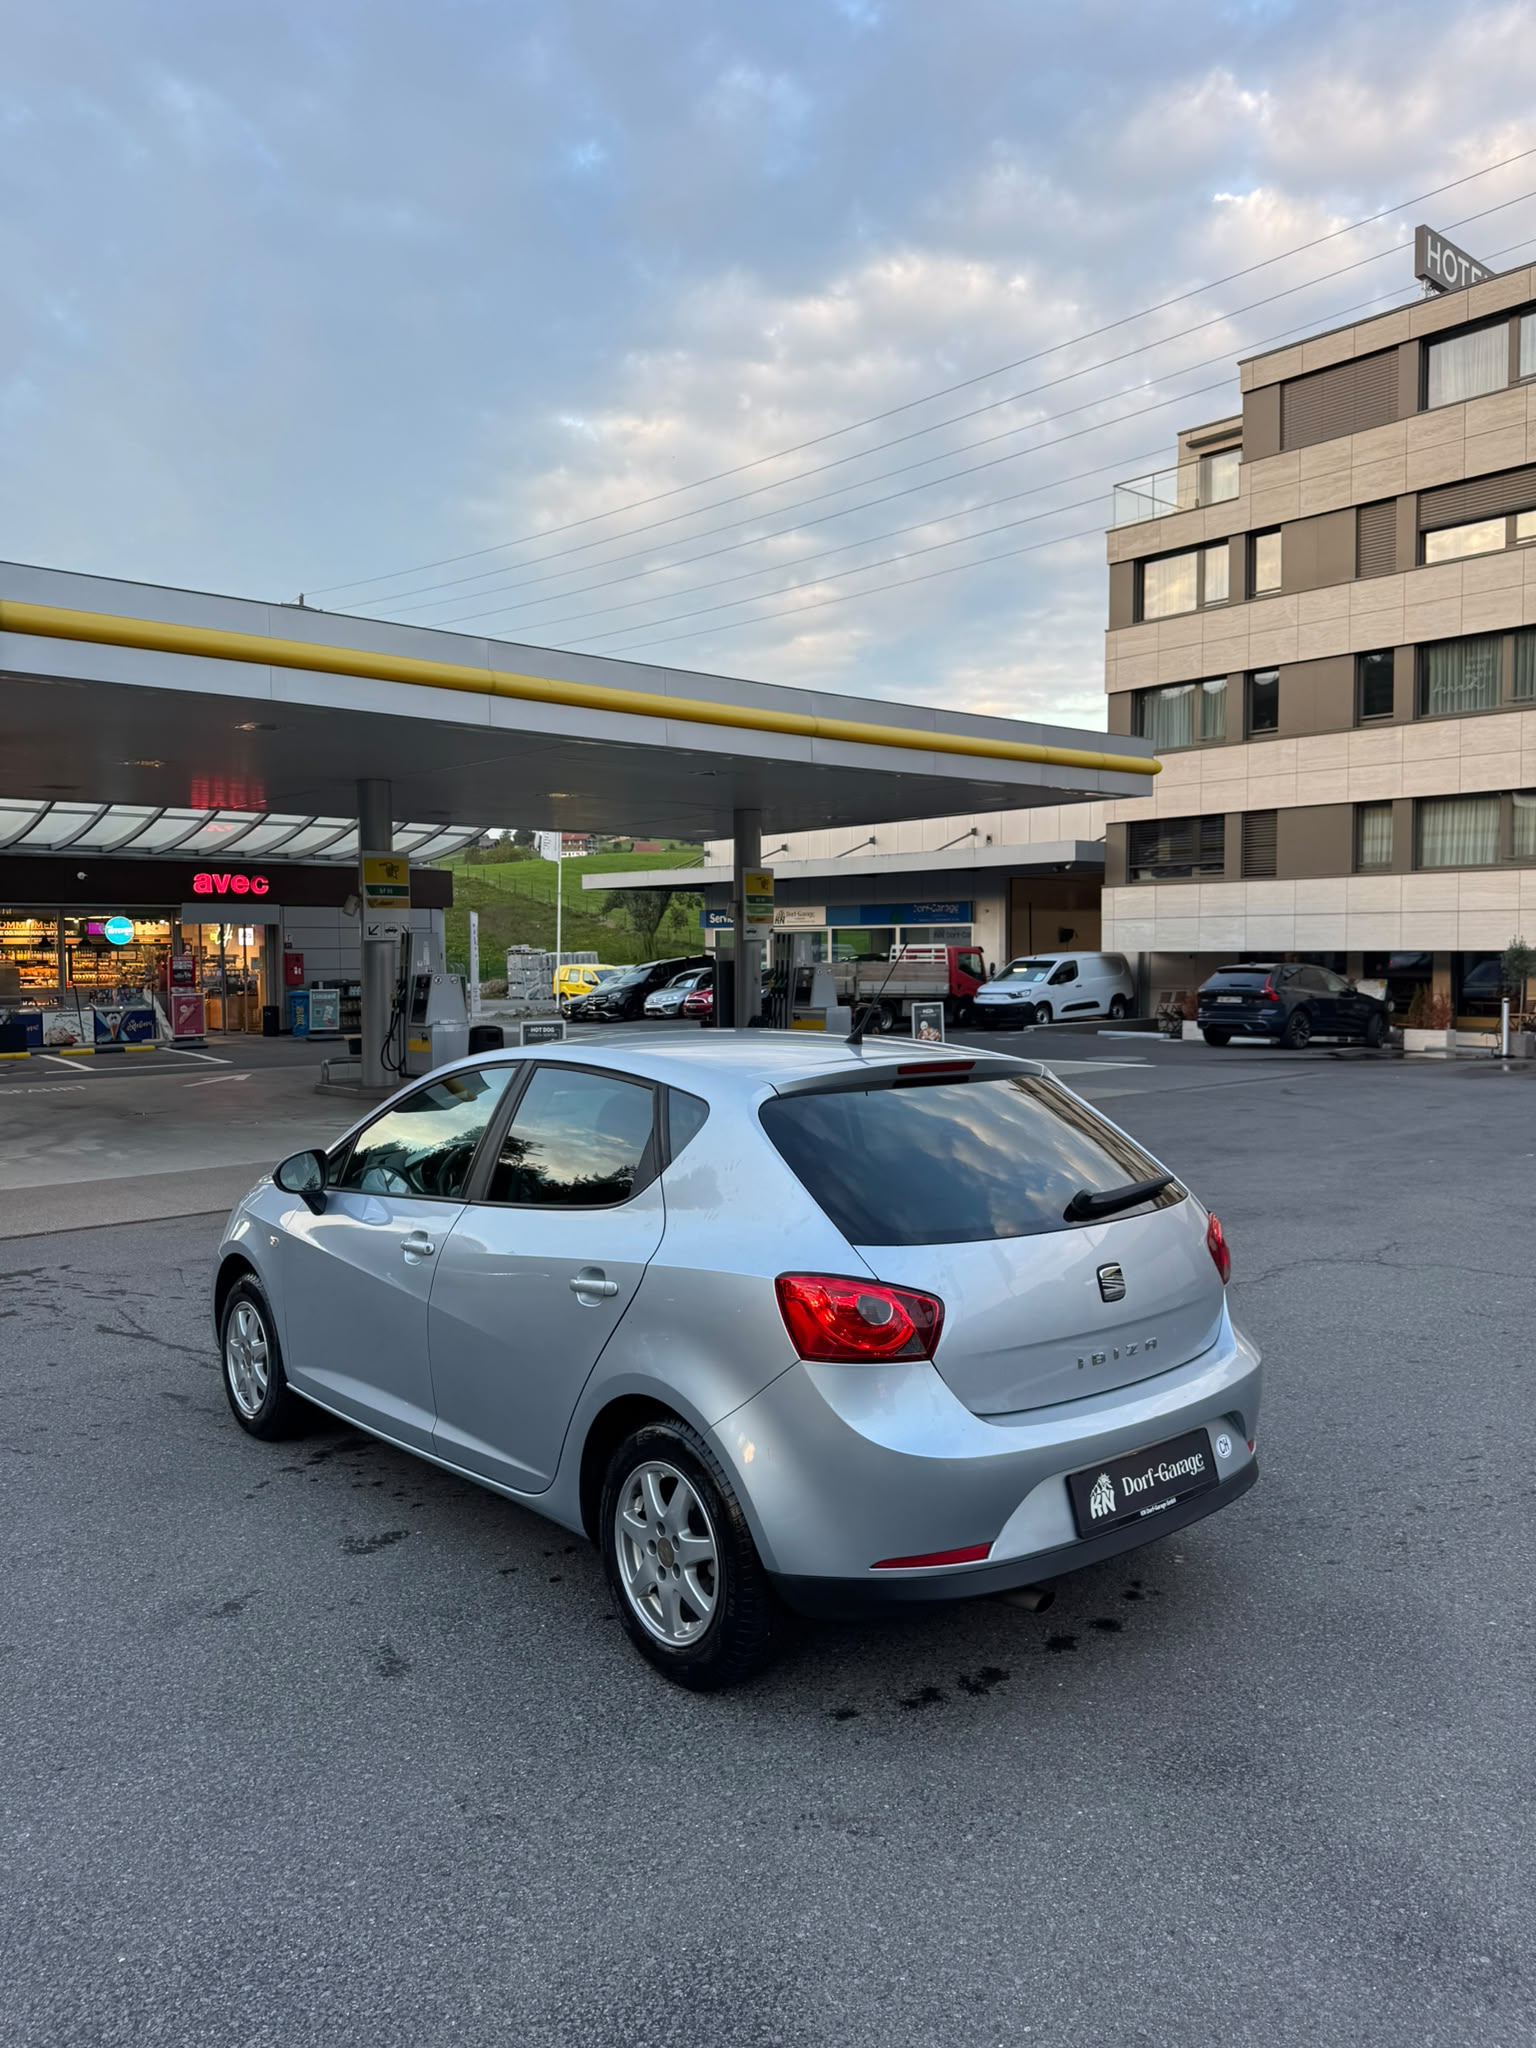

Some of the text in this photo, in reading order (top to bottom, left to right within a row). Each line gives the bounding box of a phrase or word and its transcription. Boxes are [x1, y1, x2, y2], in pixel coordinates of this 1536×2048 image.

[1427, 235, 1488, 286] HOTE
[193, 873, 269, 894] avec
[1078, 1338, 1157, 1369] IBIZA
[1219, 1439, 1230, 1454] CH
[1090, 1453, 1204, 1519] KN Dorf-Garage
